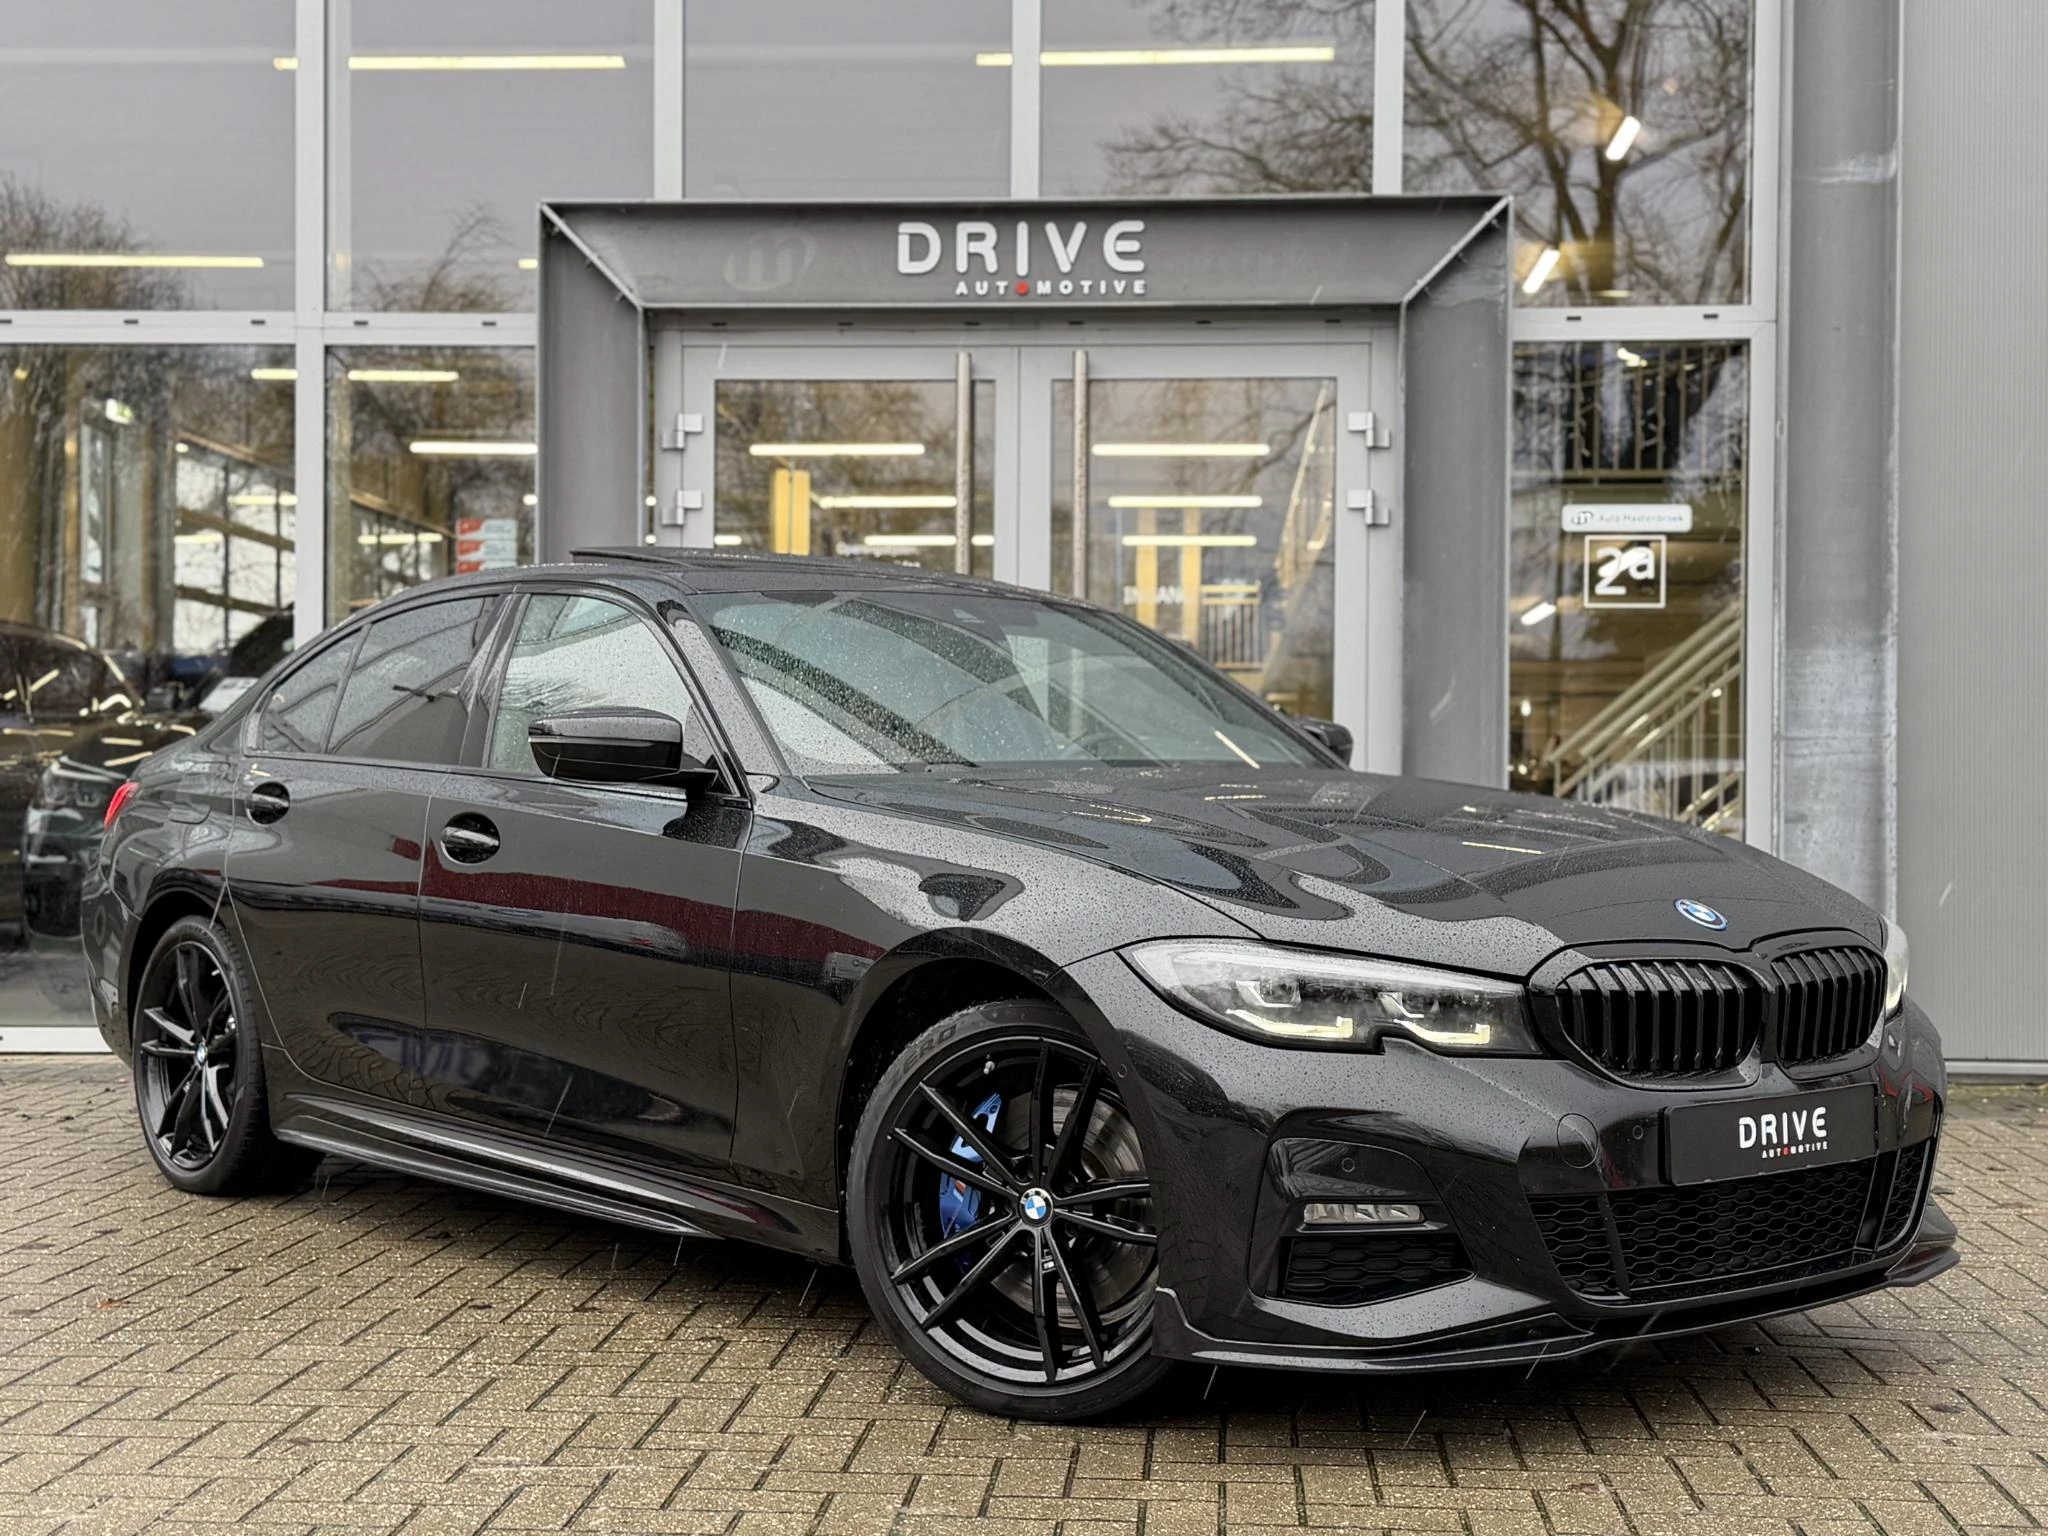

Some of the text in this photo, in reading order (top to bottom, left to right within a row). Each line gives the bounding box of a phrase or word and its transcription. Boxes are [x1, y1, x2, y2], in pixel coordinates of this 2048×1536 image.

[897, 220, 1145, 277] DRIVE
[1594, 546, 1655, 596] 2a
[1738, 1106, 1827, 1149] DRIVE
[1761, 1141, 1828, 1159] AUTOMOTIVE
